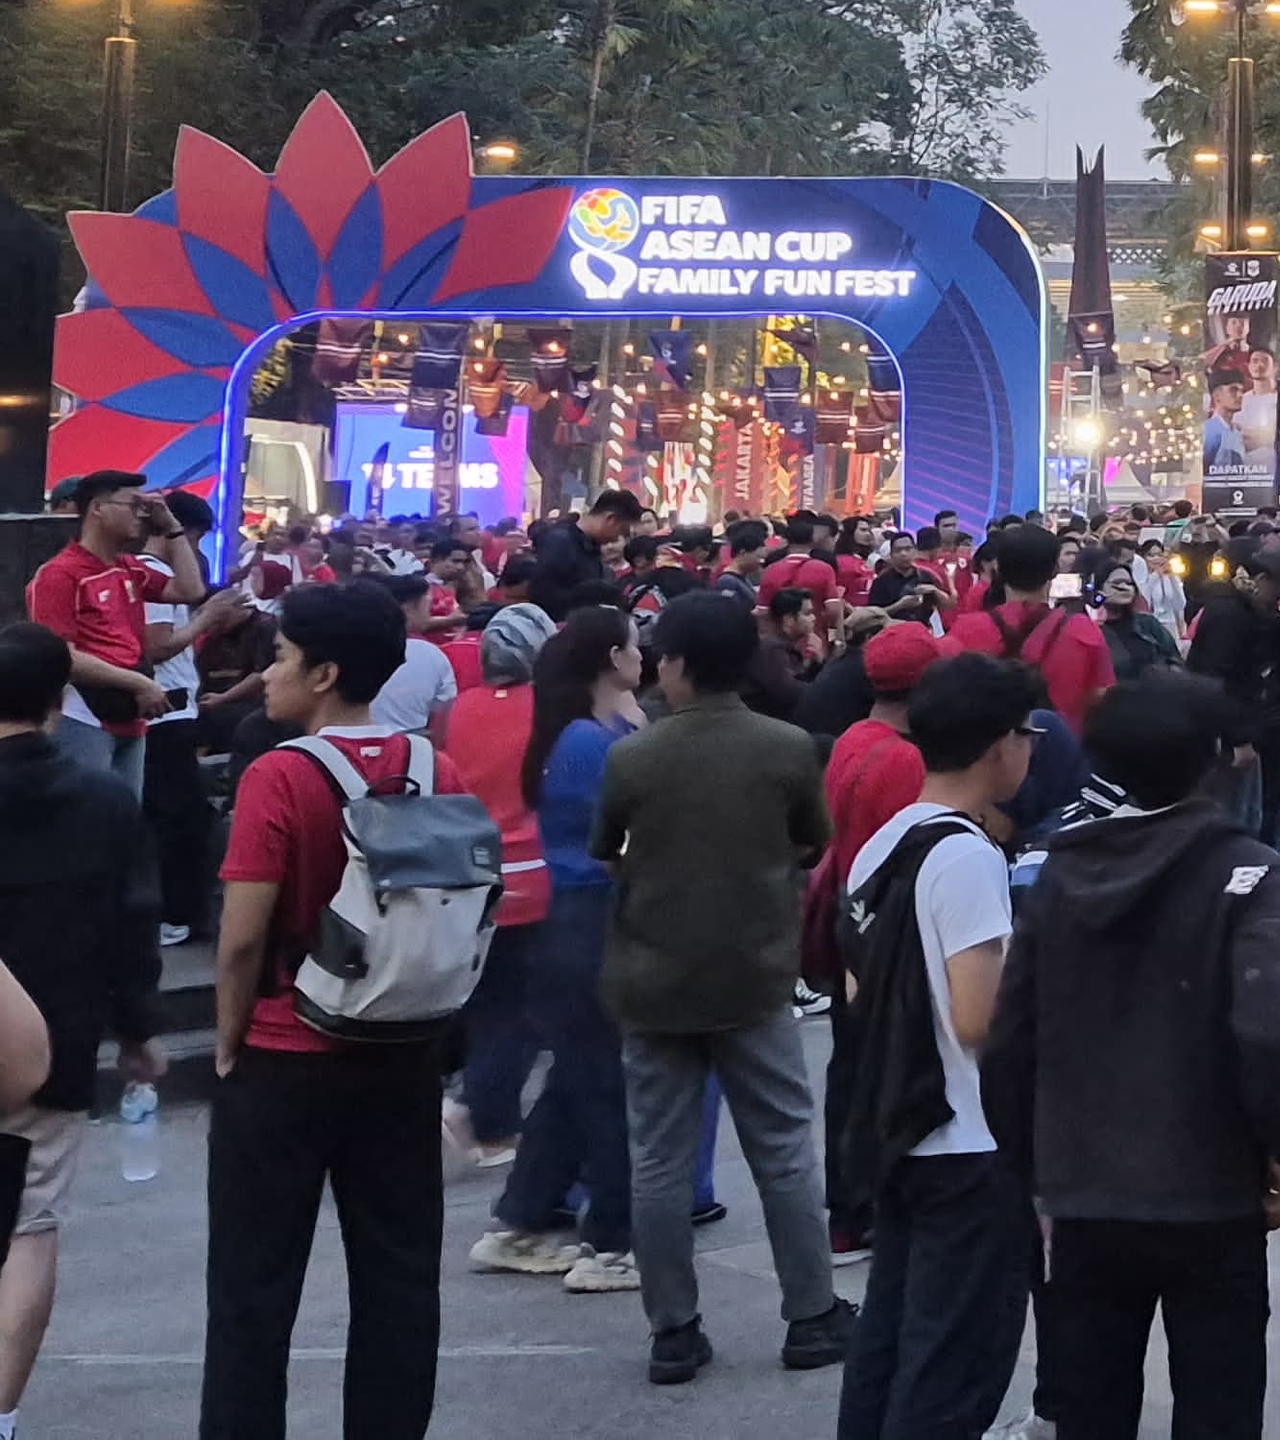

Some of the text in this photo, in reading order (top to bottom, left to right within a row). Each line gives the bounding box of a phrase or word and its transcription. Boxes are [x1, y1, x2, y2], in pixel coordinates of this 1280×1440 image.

[641, 195, 727, 225] FIFA
[640, 231, 853, 261] ASEAN CUP
[638, 267, 916, 297] FAMILY FUN FEST
[1207, 280, 1277, 308] GARUDA
[437, 385, 458, 515] WELCOM
[735, 422, 753, 500] JAKARTA
[397, 463, 498, 489] TEMS
